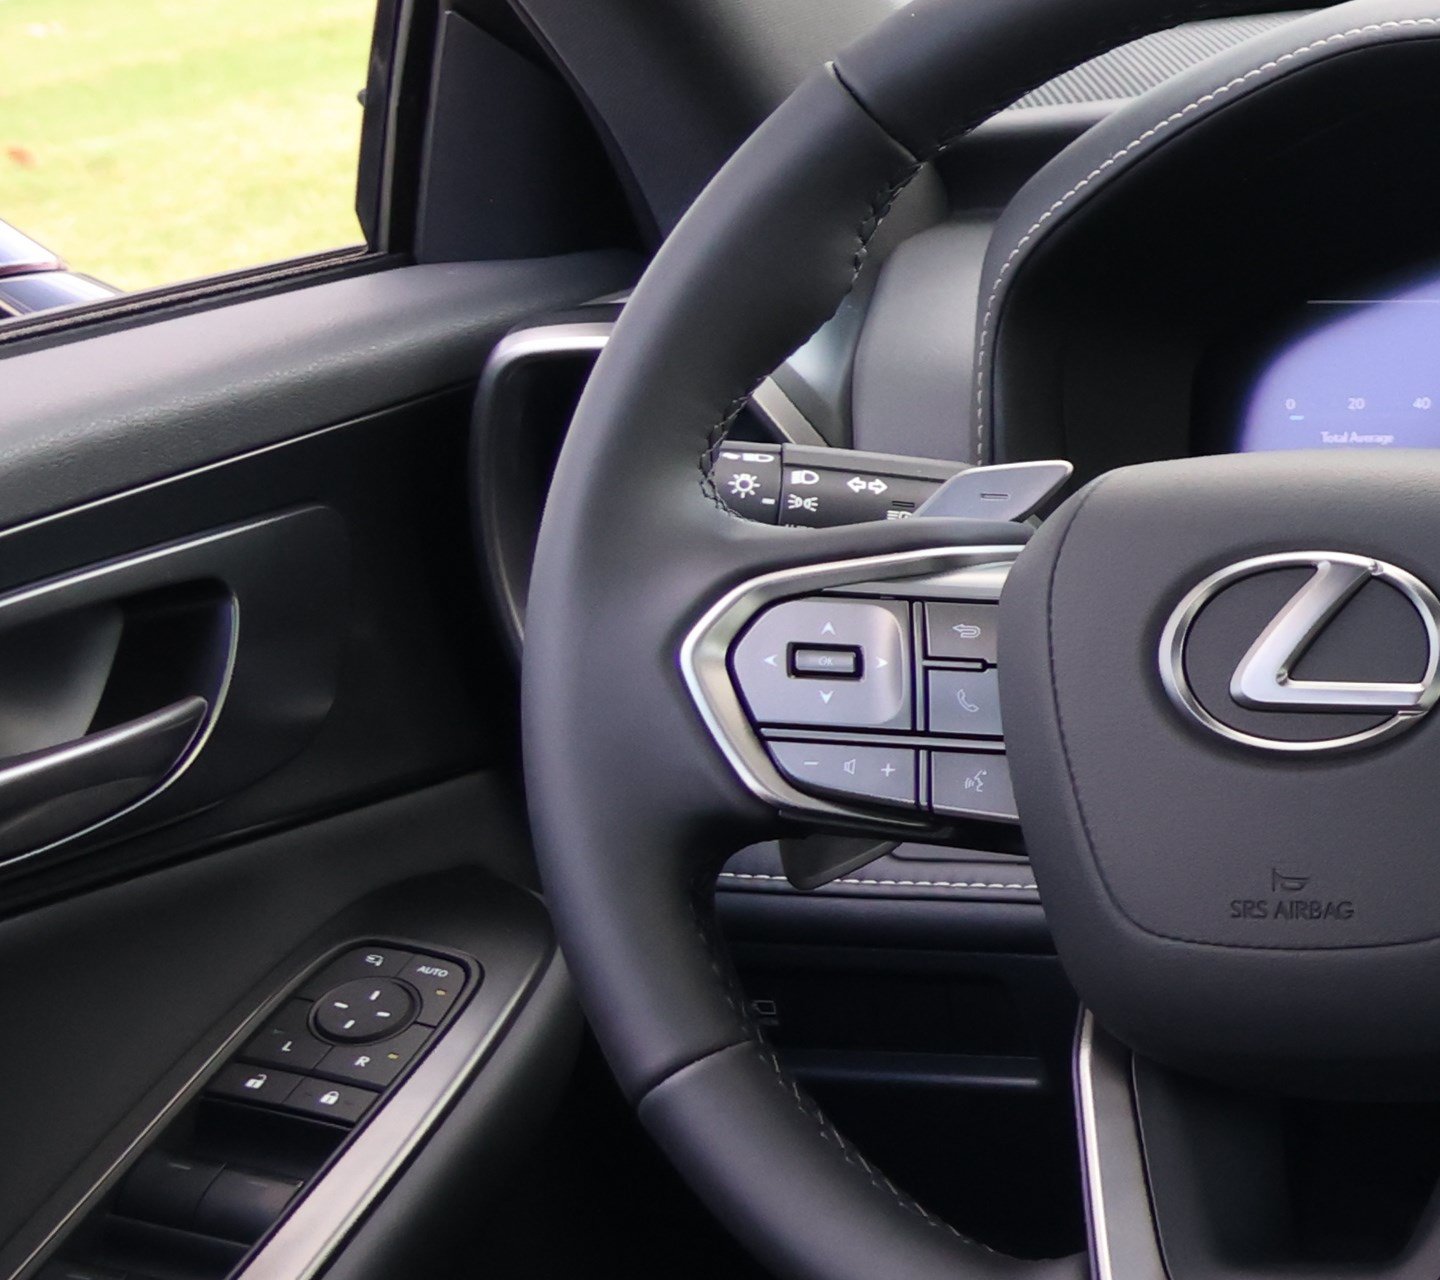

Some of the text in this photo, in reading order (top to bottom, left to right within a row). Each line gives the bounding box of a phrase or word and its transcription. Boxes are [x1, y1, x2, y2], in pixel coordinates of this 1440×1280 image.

[1348, 397, 1366, 410] 20
[1412, 396, 1432, 410] 40
[1321, 431, 1394, 446] Total Average
[1231, 899, 1355, 921] SRS AIRBAG
[417, 965, 449, 978] AUTO
